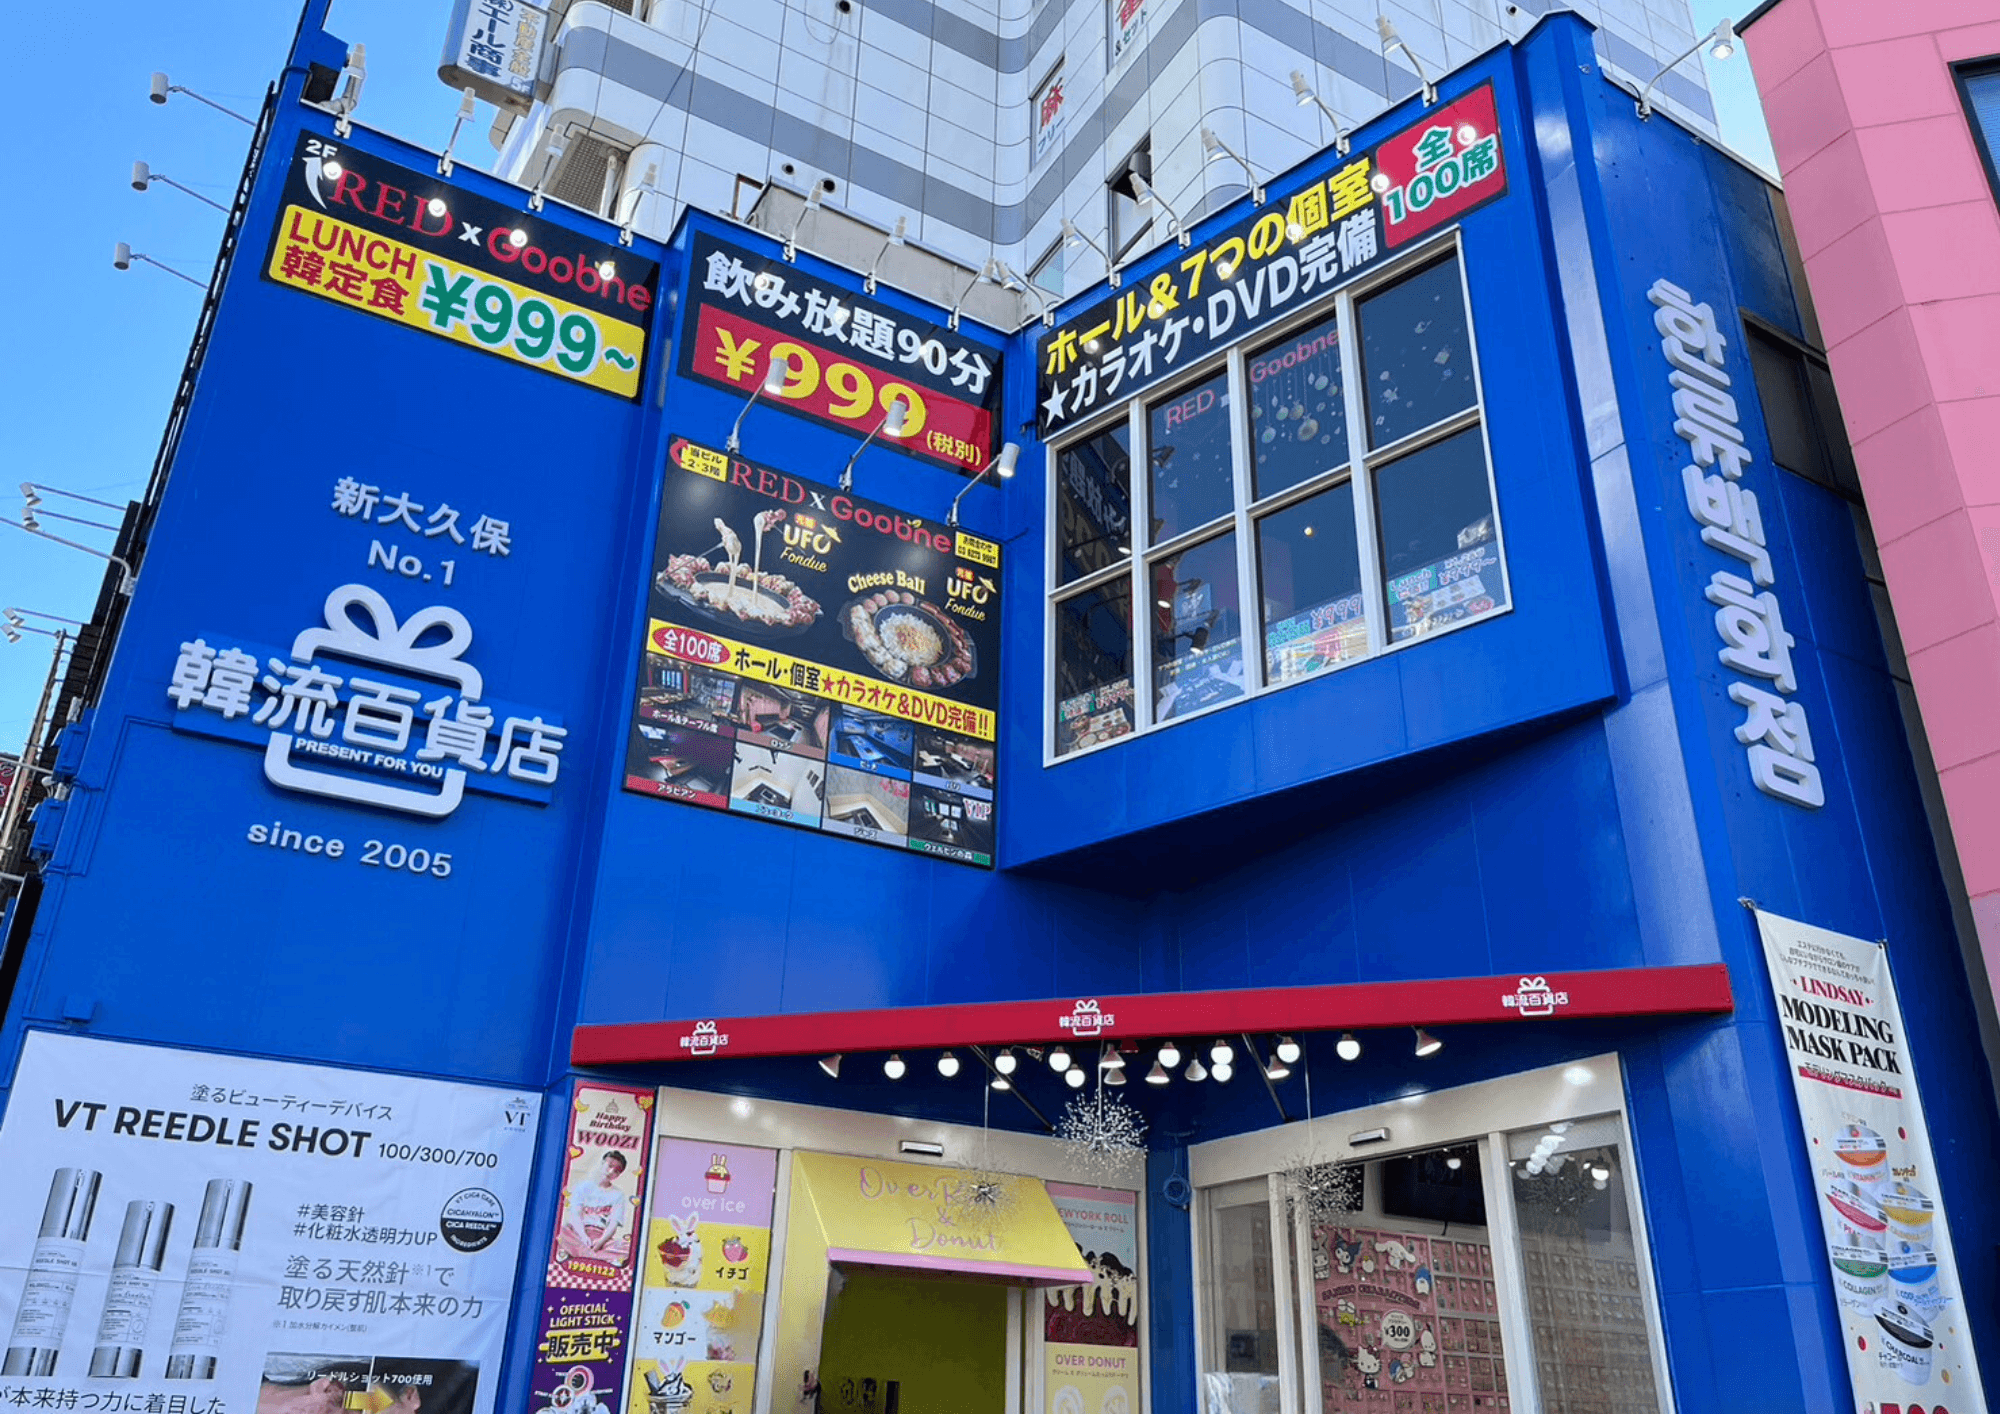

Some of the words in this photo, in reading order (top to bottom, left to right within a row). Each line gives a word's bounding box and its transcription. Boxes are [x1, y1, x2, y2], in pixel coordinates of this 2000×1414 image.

[306, 139, 338, 159] 2F
[1416, 125, 1452, 171] 全
[1383, 134, 1499, 226] 100席
[289, 211, 418, 281] LUNCH
[328, 168, 454, 237] RED
[487, 227, 652, 311] Goobne
[280, 244, 411, 316] 韓定食
[1044, 155, 1376, 376] ホール&7つの個室
[703, 250, 991, 395] 飲み放題90分
[714, 327, 927, 438] ¥999
[1166, 389, 1215, 429] RED
[1250, 330, 1340, 383] Goobne
[926, 430, 983, 467] (税別)
[331, 476, 512, 556] 新大久保
[729, 460, 806, 505] RED
[831, 495, 953, 554] Goobne
[783, 524, 831, 554] UFO
[1647, 278, 1825, 809] 한류백화점
[367, 540, 456, 586] No.1
[780, 546, 828, 573] Fondue
[847, 571, 894, 594] Cheese
[895, 569, 926, 595] Ball
[946, 577, 989, 605] UFO
[944, 597, 986, 621] Fondue
[663, 632, 722, 663] 全100席
[167, 638, 568, 785] 韓流百貨店
[295, 737, 372, 764] PRESENT
[374, 754, 407, 771] FOR
[410, 762, 444, 779] YOU
[963, 799, 992, 821] VIP
[247, 821, 345, 859] since
[360, 839, 453, 878] 2005
[1799, 975, 1865, 1008] LINDSAY
[1779, 994, 1895, 1044] MODELING
[1785, 1025, 1848, 1063] MASK
[1848, 1041, 1902, 1075] PACK
[190, 1083, 394, 1122] 塗るビューティーデバイス
[504, 1110, 531, 1126] VT
[596, 1111, 628, 1123] Happy
[54, 1098, 106, 1132] VT
[113, 1108, 260, 1148] REEDLE
[268, 1121, 372, 1158] SHOT
[378, 1142, 499, 1169] 100/300/700
[577, 1130, 641, 1150] WOOZI
[590, 1119, 632, 1133] Birthday
[297, 1203, 365, 1223] #美容針
[681, 1195, 717, 1211] over
[1058, 1207, 1102, 1221] EWYORK
[1103, 1212, 1130, 1225] ROLL
[293, 1222, 438, 1246] #化粧水透明力UP
[905, 1216, 997, 1253] Donut
[715, 1266, 750, 1280] イチゴ
[277, 1284, 484, 1319] 取り戻す肌本来の力
[560, 1302, 608, 1316] OFFICIAL
[549, 1316, 582, 1329] LIGHT
[584, 1313, 615, 1327] STICK
[546, 1330, 613, 1359] 販売中
[653, 1331, 697, 1345] マンゴー
[306, 1368, 434, 1386] リードルショット700使用
[1055, 1353, 1086, 1367] OVER
[1087, 1355, 1127, 1369] DONUT
